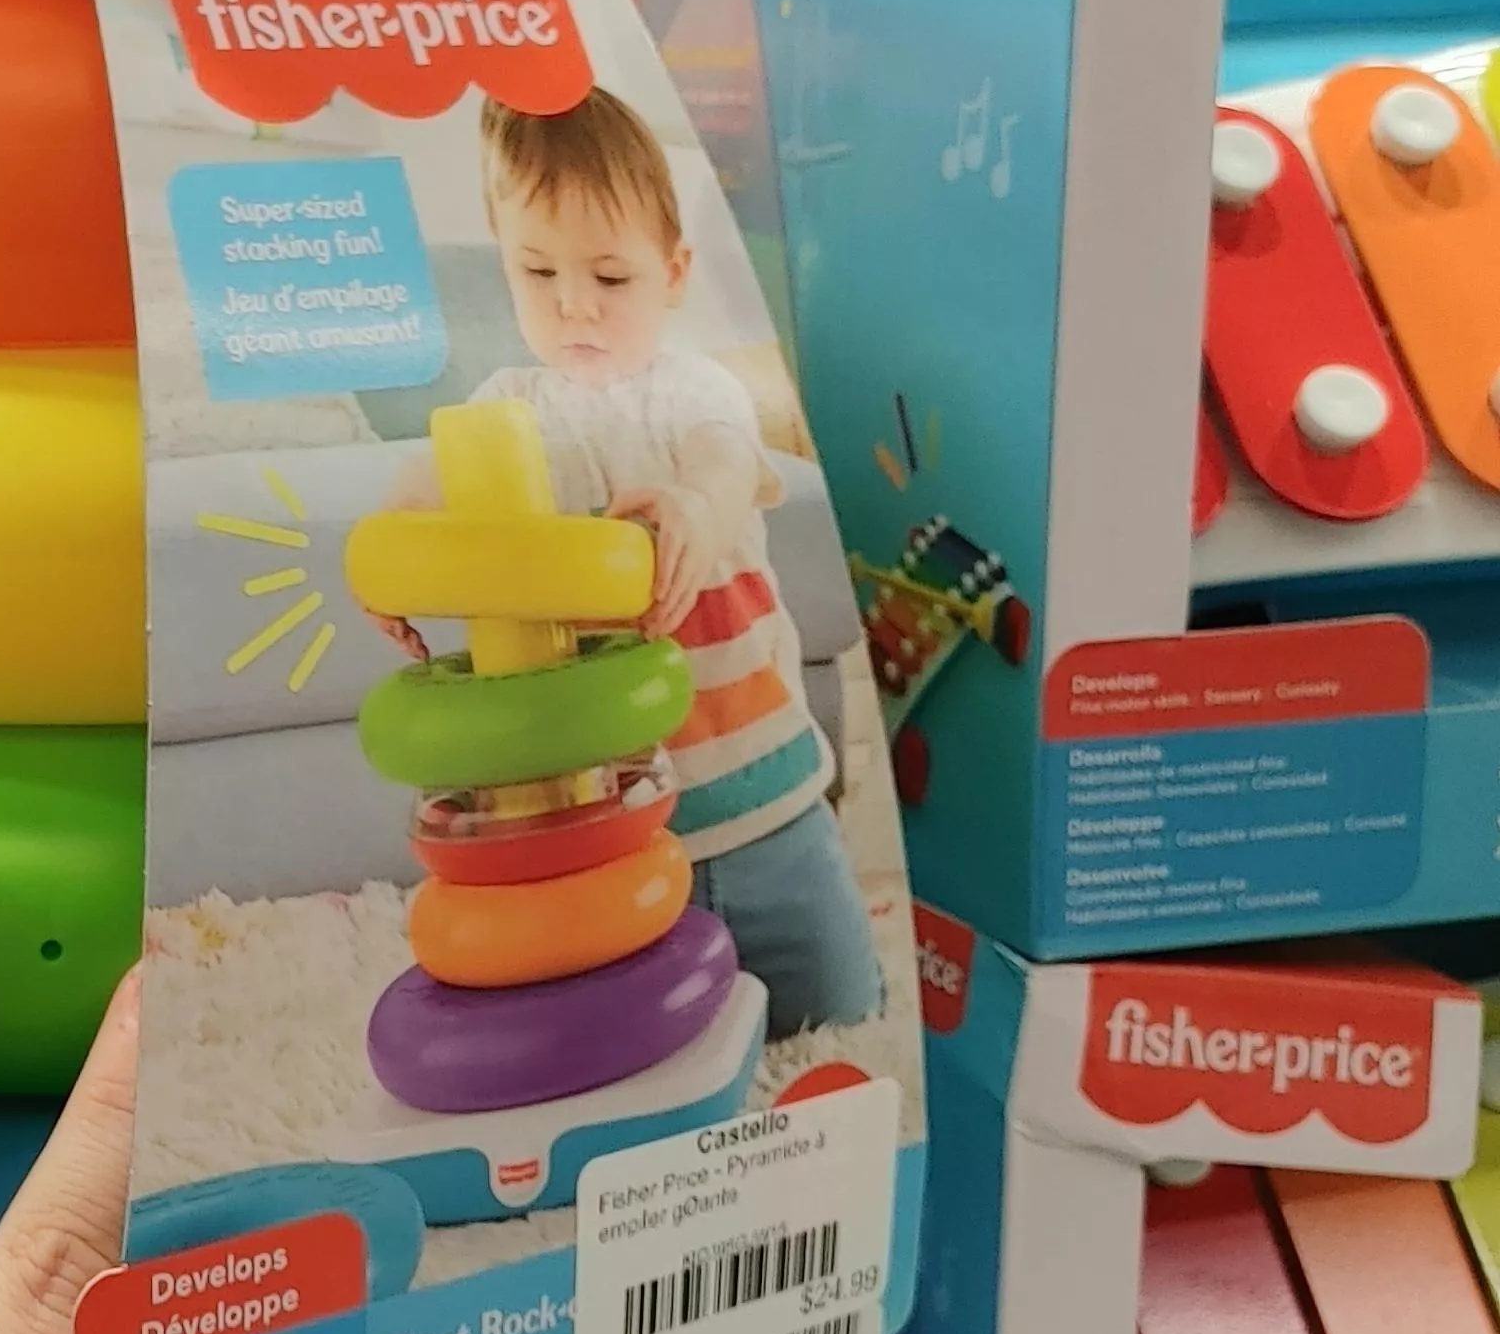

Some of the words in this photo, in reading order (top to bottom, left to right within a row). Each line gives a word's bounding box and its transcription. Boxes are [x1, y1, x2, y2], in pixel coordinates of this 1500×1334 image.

[220, 189, 366, 229] Super-sized
[223, 233, 331, 266] stacking
[334, 225, 385, 257] fun!
[222, 285, 269, 315] Jeu
[273, 277, 410, 315] d'empilage
[224, 325, 304, 364] géant
[308, 313, 422, 349] amusant!
[1105, 998, 1413, 1093] fisher-price
[697, 1111, 789, 1154] Castello
[598, 1182, 658, 1214] Fisher
[727, 1138, 810, 1179] Pyramide
[598, 1208, 666, 1244] empiler
[151, 1247, 289, 1306] Develops
[799, 1264, 878, 1315] $24.99
